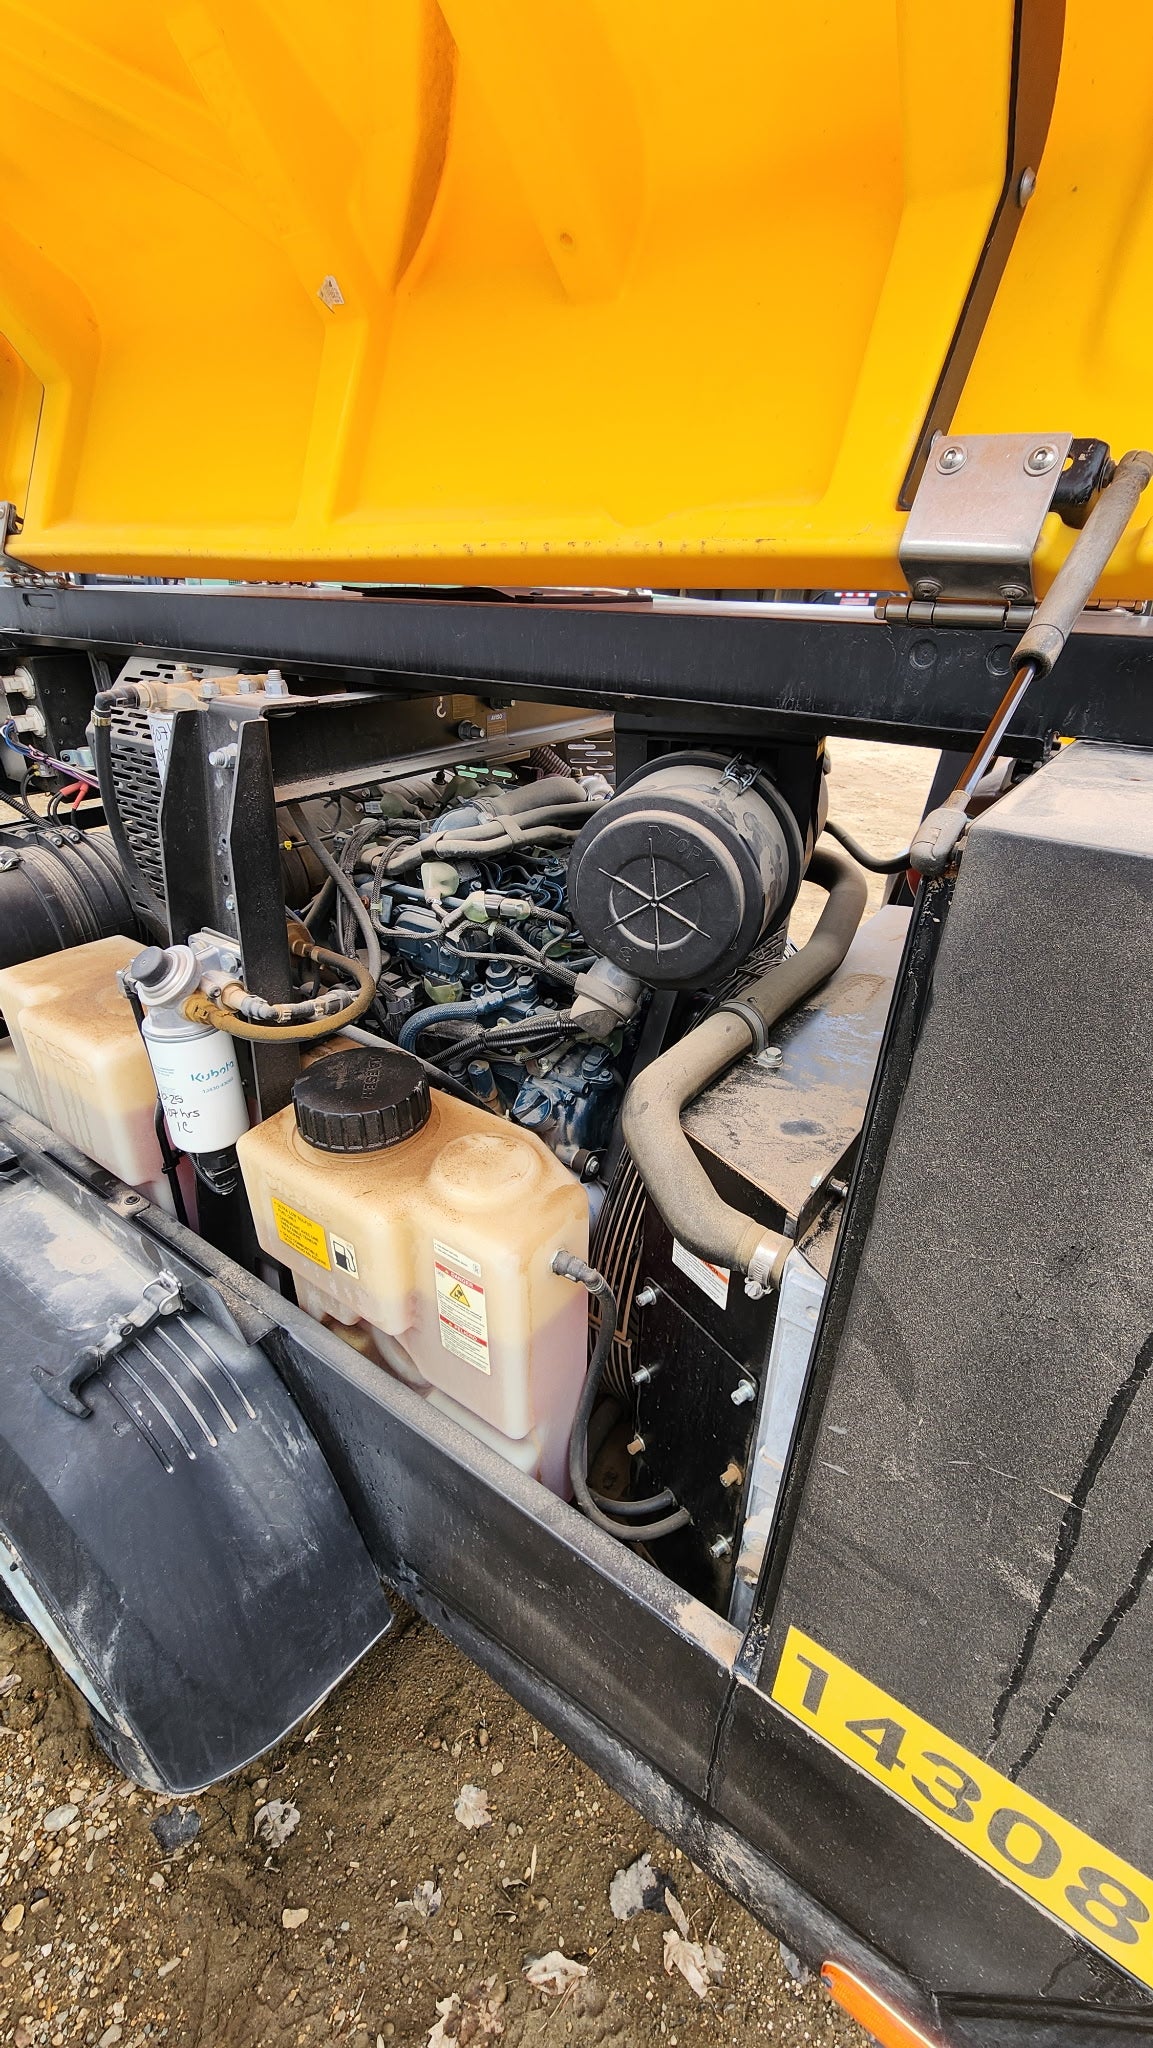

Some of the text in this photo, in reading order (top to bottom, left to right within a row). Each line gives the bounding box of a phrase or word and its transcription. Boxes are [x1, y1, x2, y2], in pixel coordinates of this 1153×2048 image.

[191, 1060, 235, 1082] Kubota
[450, 1271, 474, 1289] DANGER
[453, 1325, 479, 1342] PELIGRO
[796, 1653, 1150, 1946] 14308
